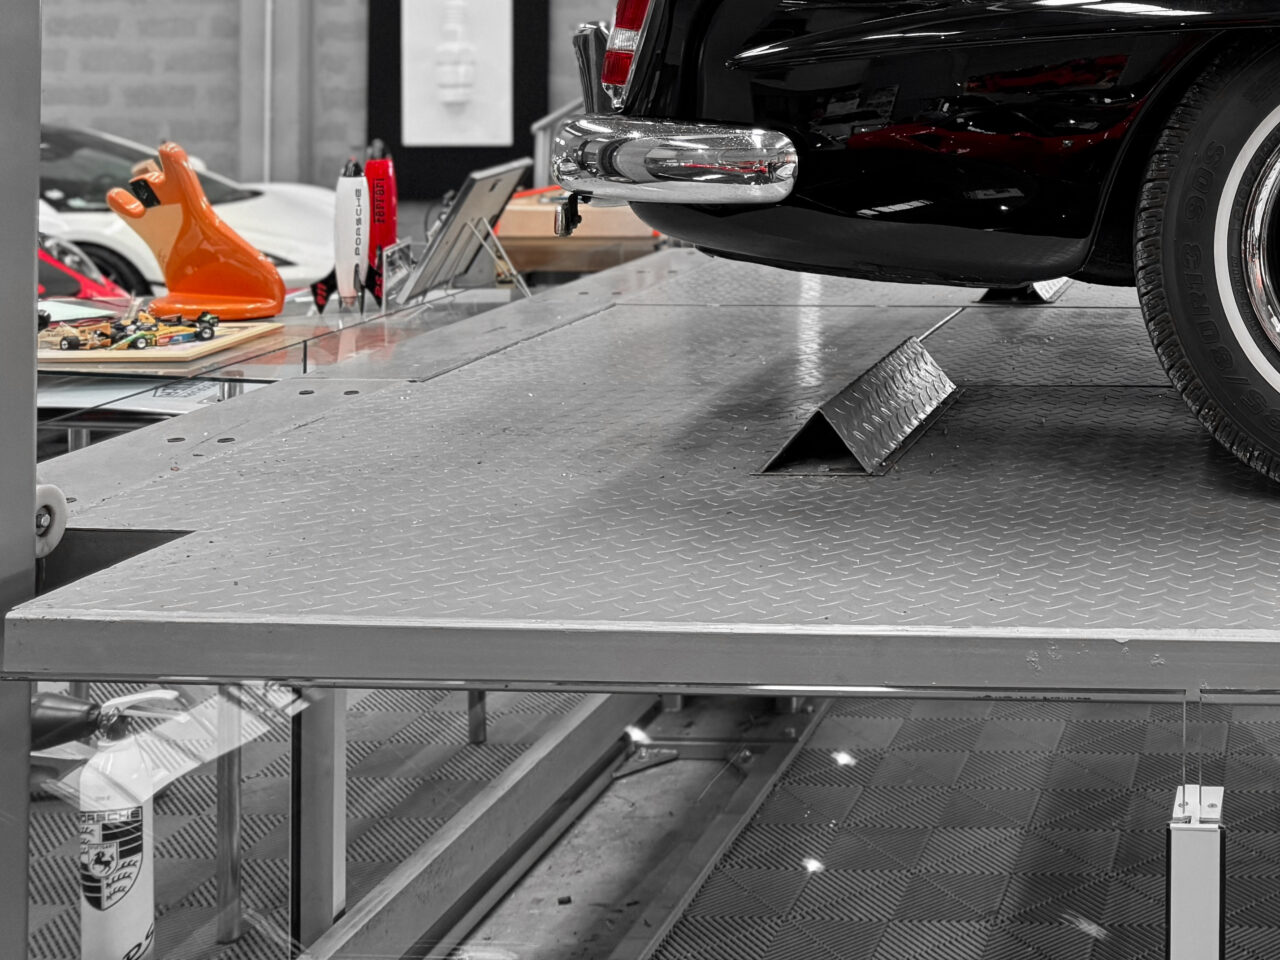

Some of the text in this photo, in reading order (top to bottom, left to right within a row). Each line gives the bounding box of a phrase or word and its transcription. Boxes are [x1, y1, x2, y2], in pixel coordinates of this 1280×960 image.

[373, 177, 386, 225] Ferrari
[1184, 140, 1226, 222] 90S
[354, 188, 362, 257] PORSCHE
[80, 810, 140, 824] ORSCHE
